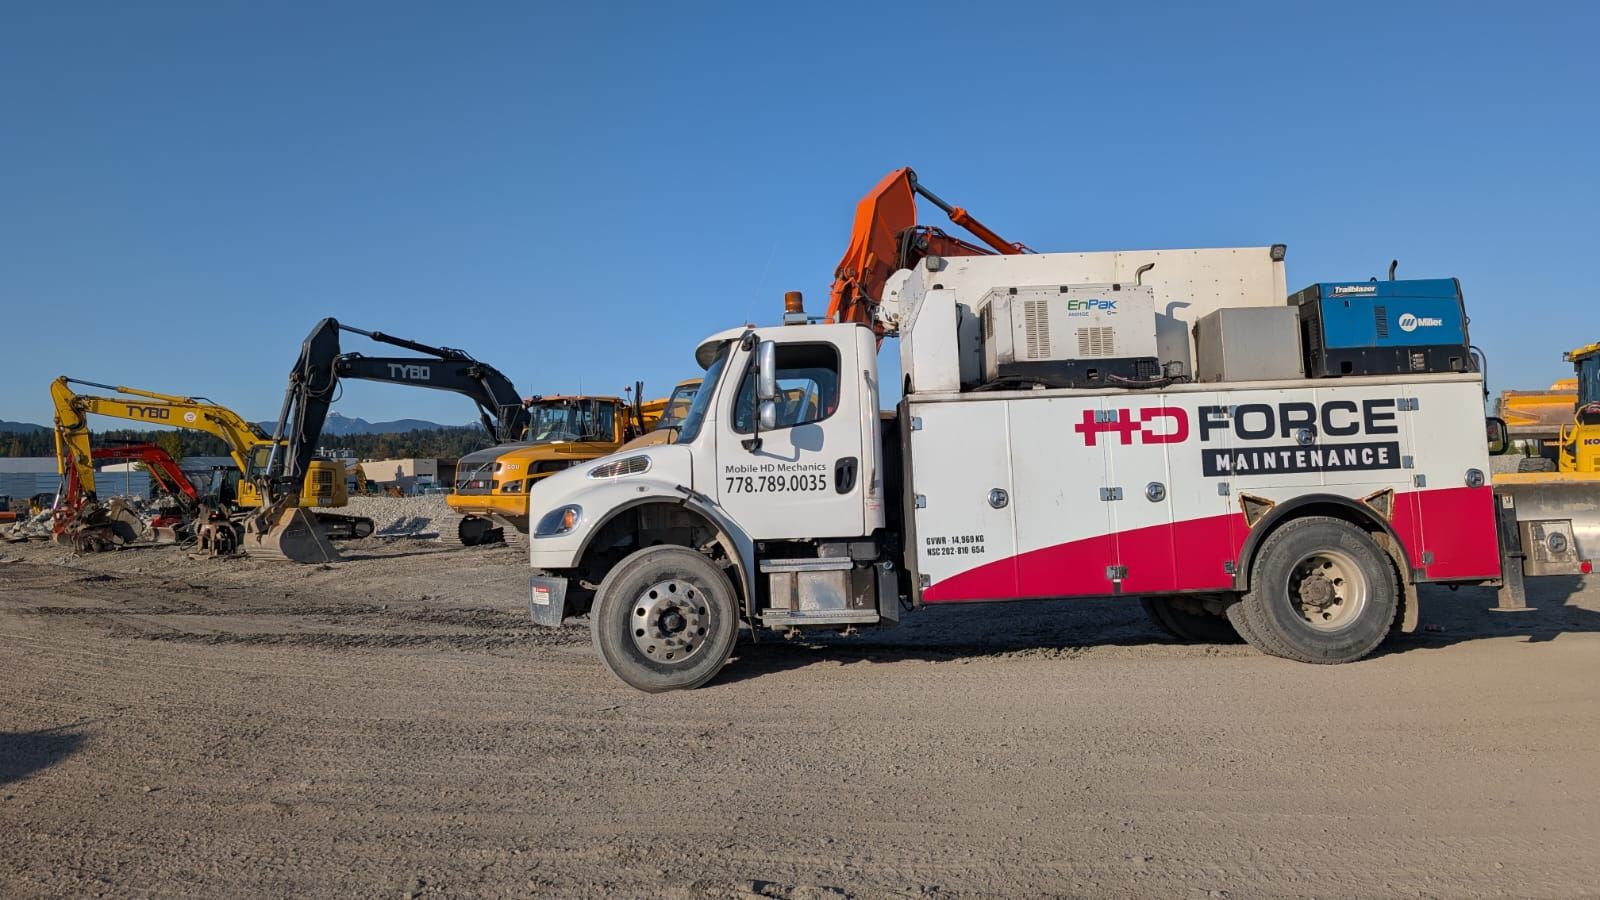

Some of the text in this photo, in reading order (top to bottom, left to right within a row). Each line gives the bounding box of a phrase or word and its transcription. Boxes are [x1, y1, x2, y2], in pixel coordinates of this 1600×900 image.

[1335, 282, 1376, 293] Trailblazer
[1068, 299, 1117, 310] EnPak
[1418, 318, 1442, 327] Miller
[387, 363, 430, 380] TYBO
[126, 405, 170, 419] TYBO
[1075, 399, 1399, 446] HD FORCE
[1215, 447, 1389, 471] MAINTENANCE
[725, 462, 826, 473] Mobile HD Mechanics
[726, 474, 827, 494] 778.789.0035
[926, 536, 946, 545] GVWR
[975, 534, 985, 543] KG
[927, 547, 941, 556] NSC
[971, 546, 985, 554] 654
